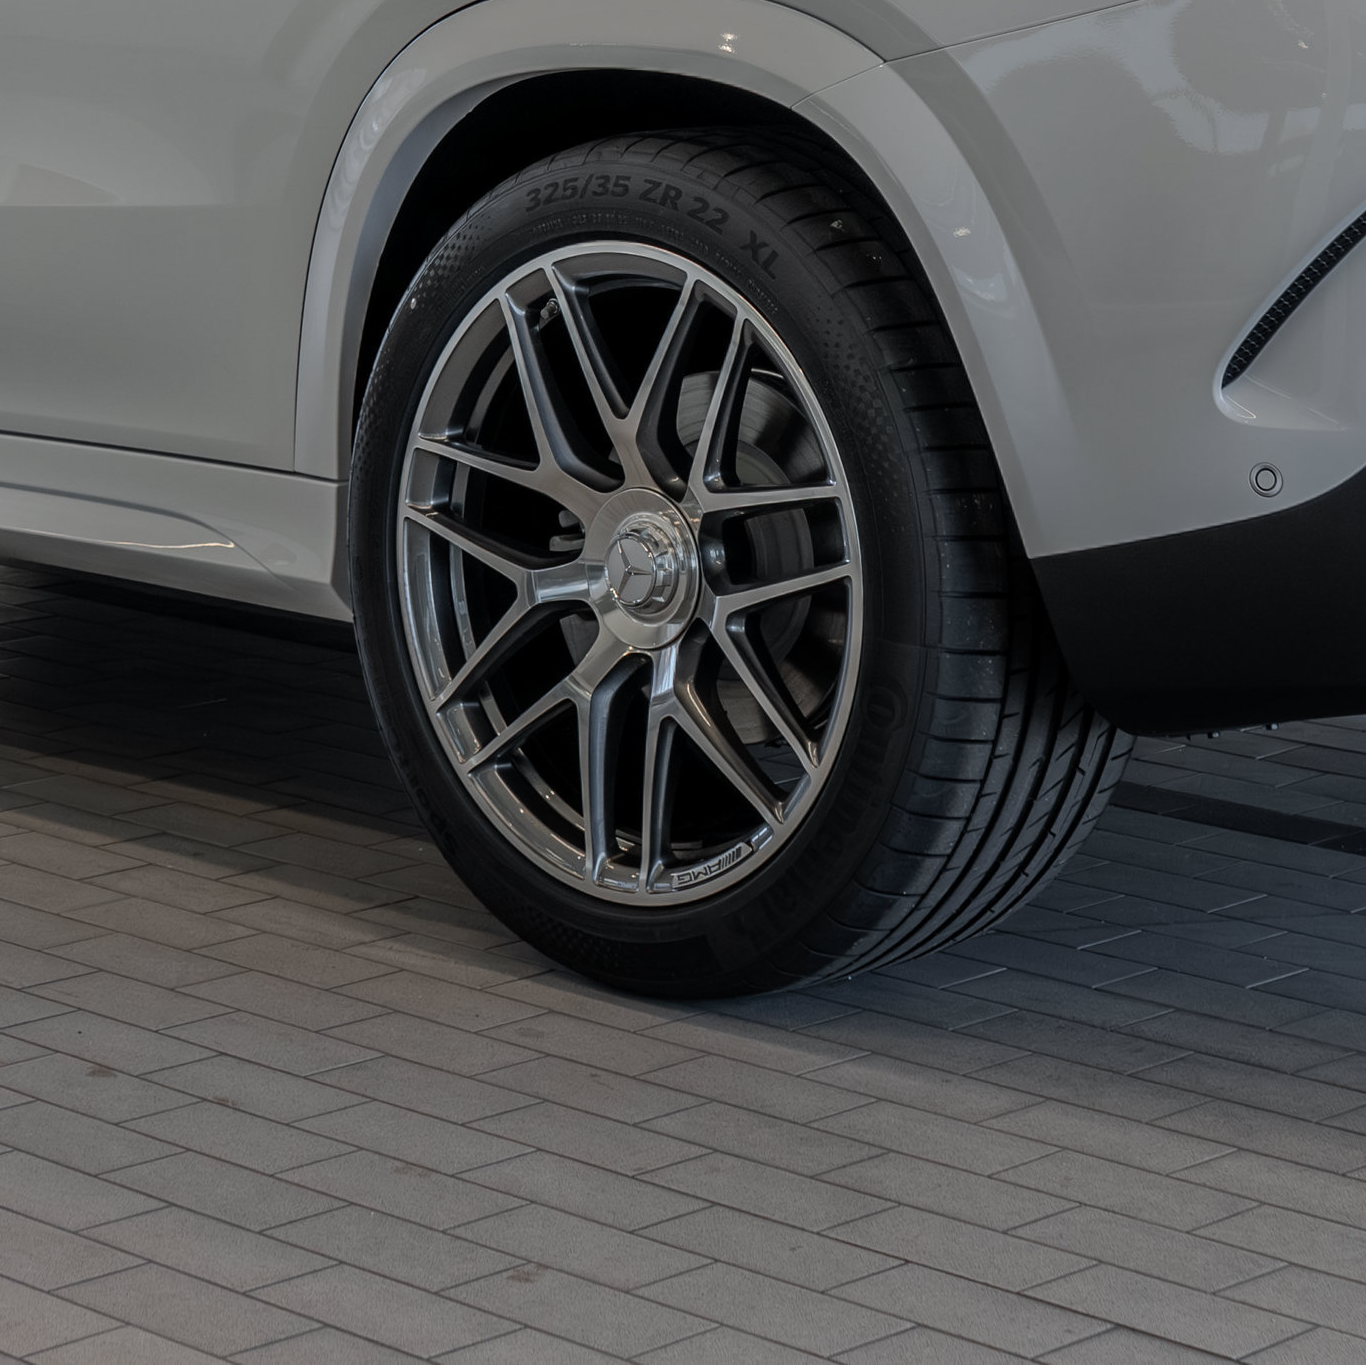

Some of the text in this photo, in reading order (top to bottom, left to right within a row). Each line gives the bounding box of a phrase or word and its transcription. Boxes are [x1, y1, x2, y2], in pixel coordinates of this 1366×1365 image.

[525, 174, 632, 214] 325/35
[637, 177, 683, 211] ZR
[686, 196, 730, 234] 22
[739, 230, 780, 280] XL
[677, 858, 722, 885] AMG
